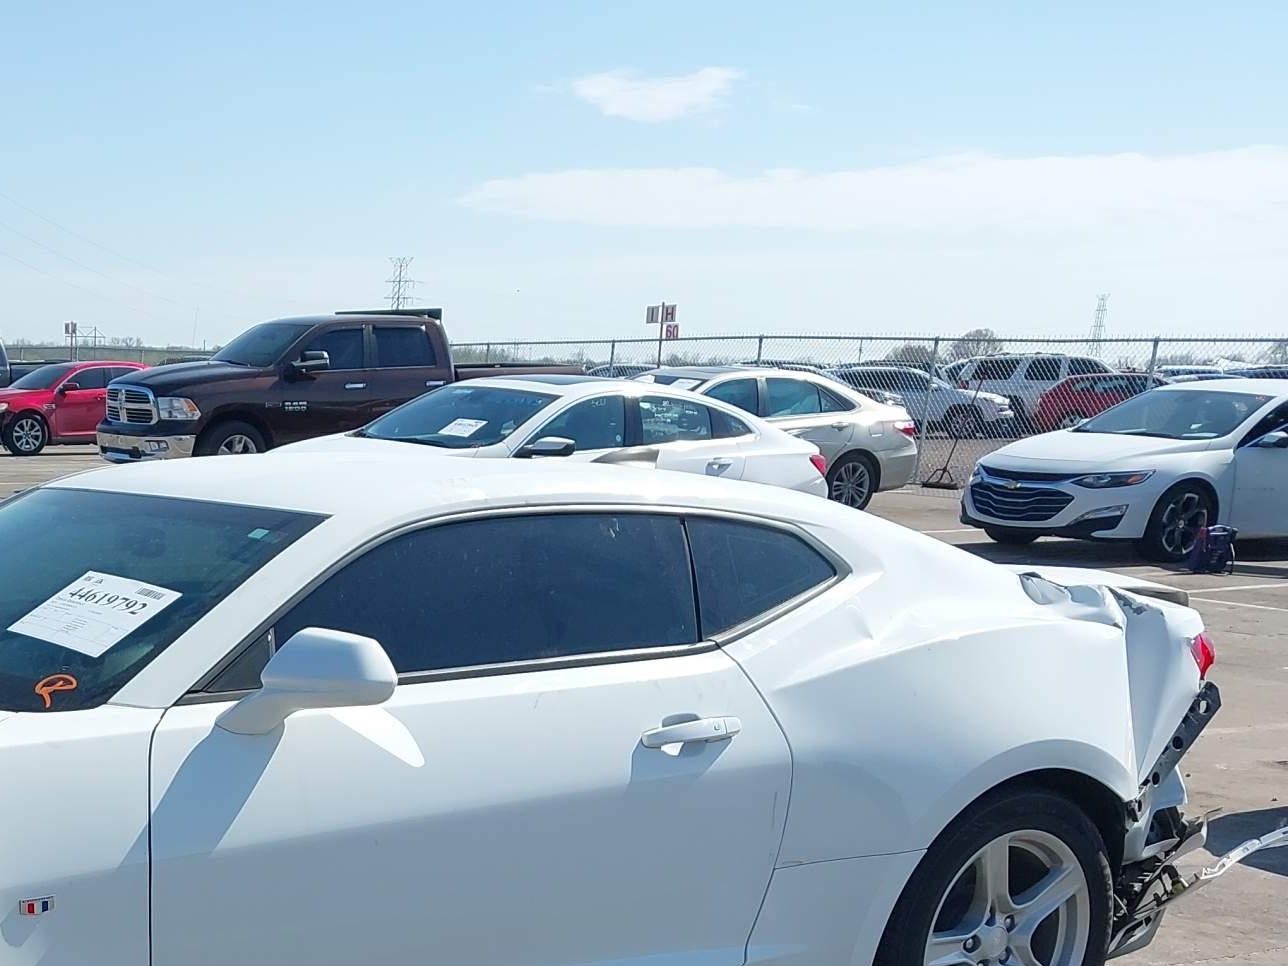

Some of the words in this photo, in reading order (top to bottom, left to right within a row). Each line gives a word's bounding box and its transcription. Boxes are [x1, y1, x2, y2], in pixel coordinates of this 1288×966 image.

[665, 306, 675, 321] H
[665, 324, 679, 339] 60
[68, 587, 149, 616] 44619792
